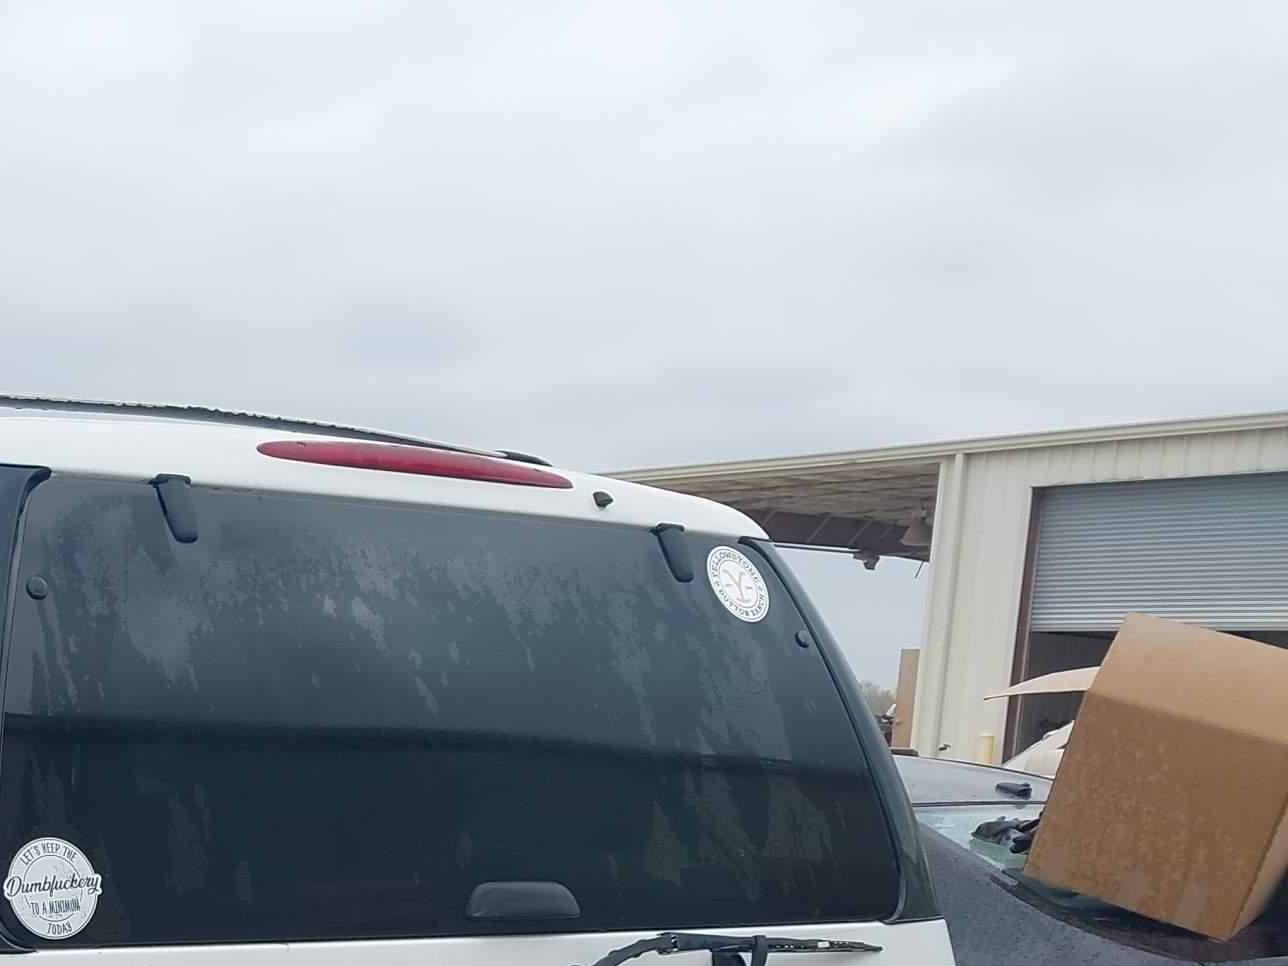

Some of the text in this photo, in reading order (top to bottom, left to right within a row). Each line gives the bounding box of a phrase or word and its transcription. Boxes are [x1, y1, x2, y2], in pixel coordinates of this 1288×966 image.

[19, 842, 79, 866] LET'S KEEP THE
[6, 873, 100, 897] Dumbfuckery
[30, 899, 80, 915] TO A MINIMUM
[47, 922, 72, 935] TODAY
